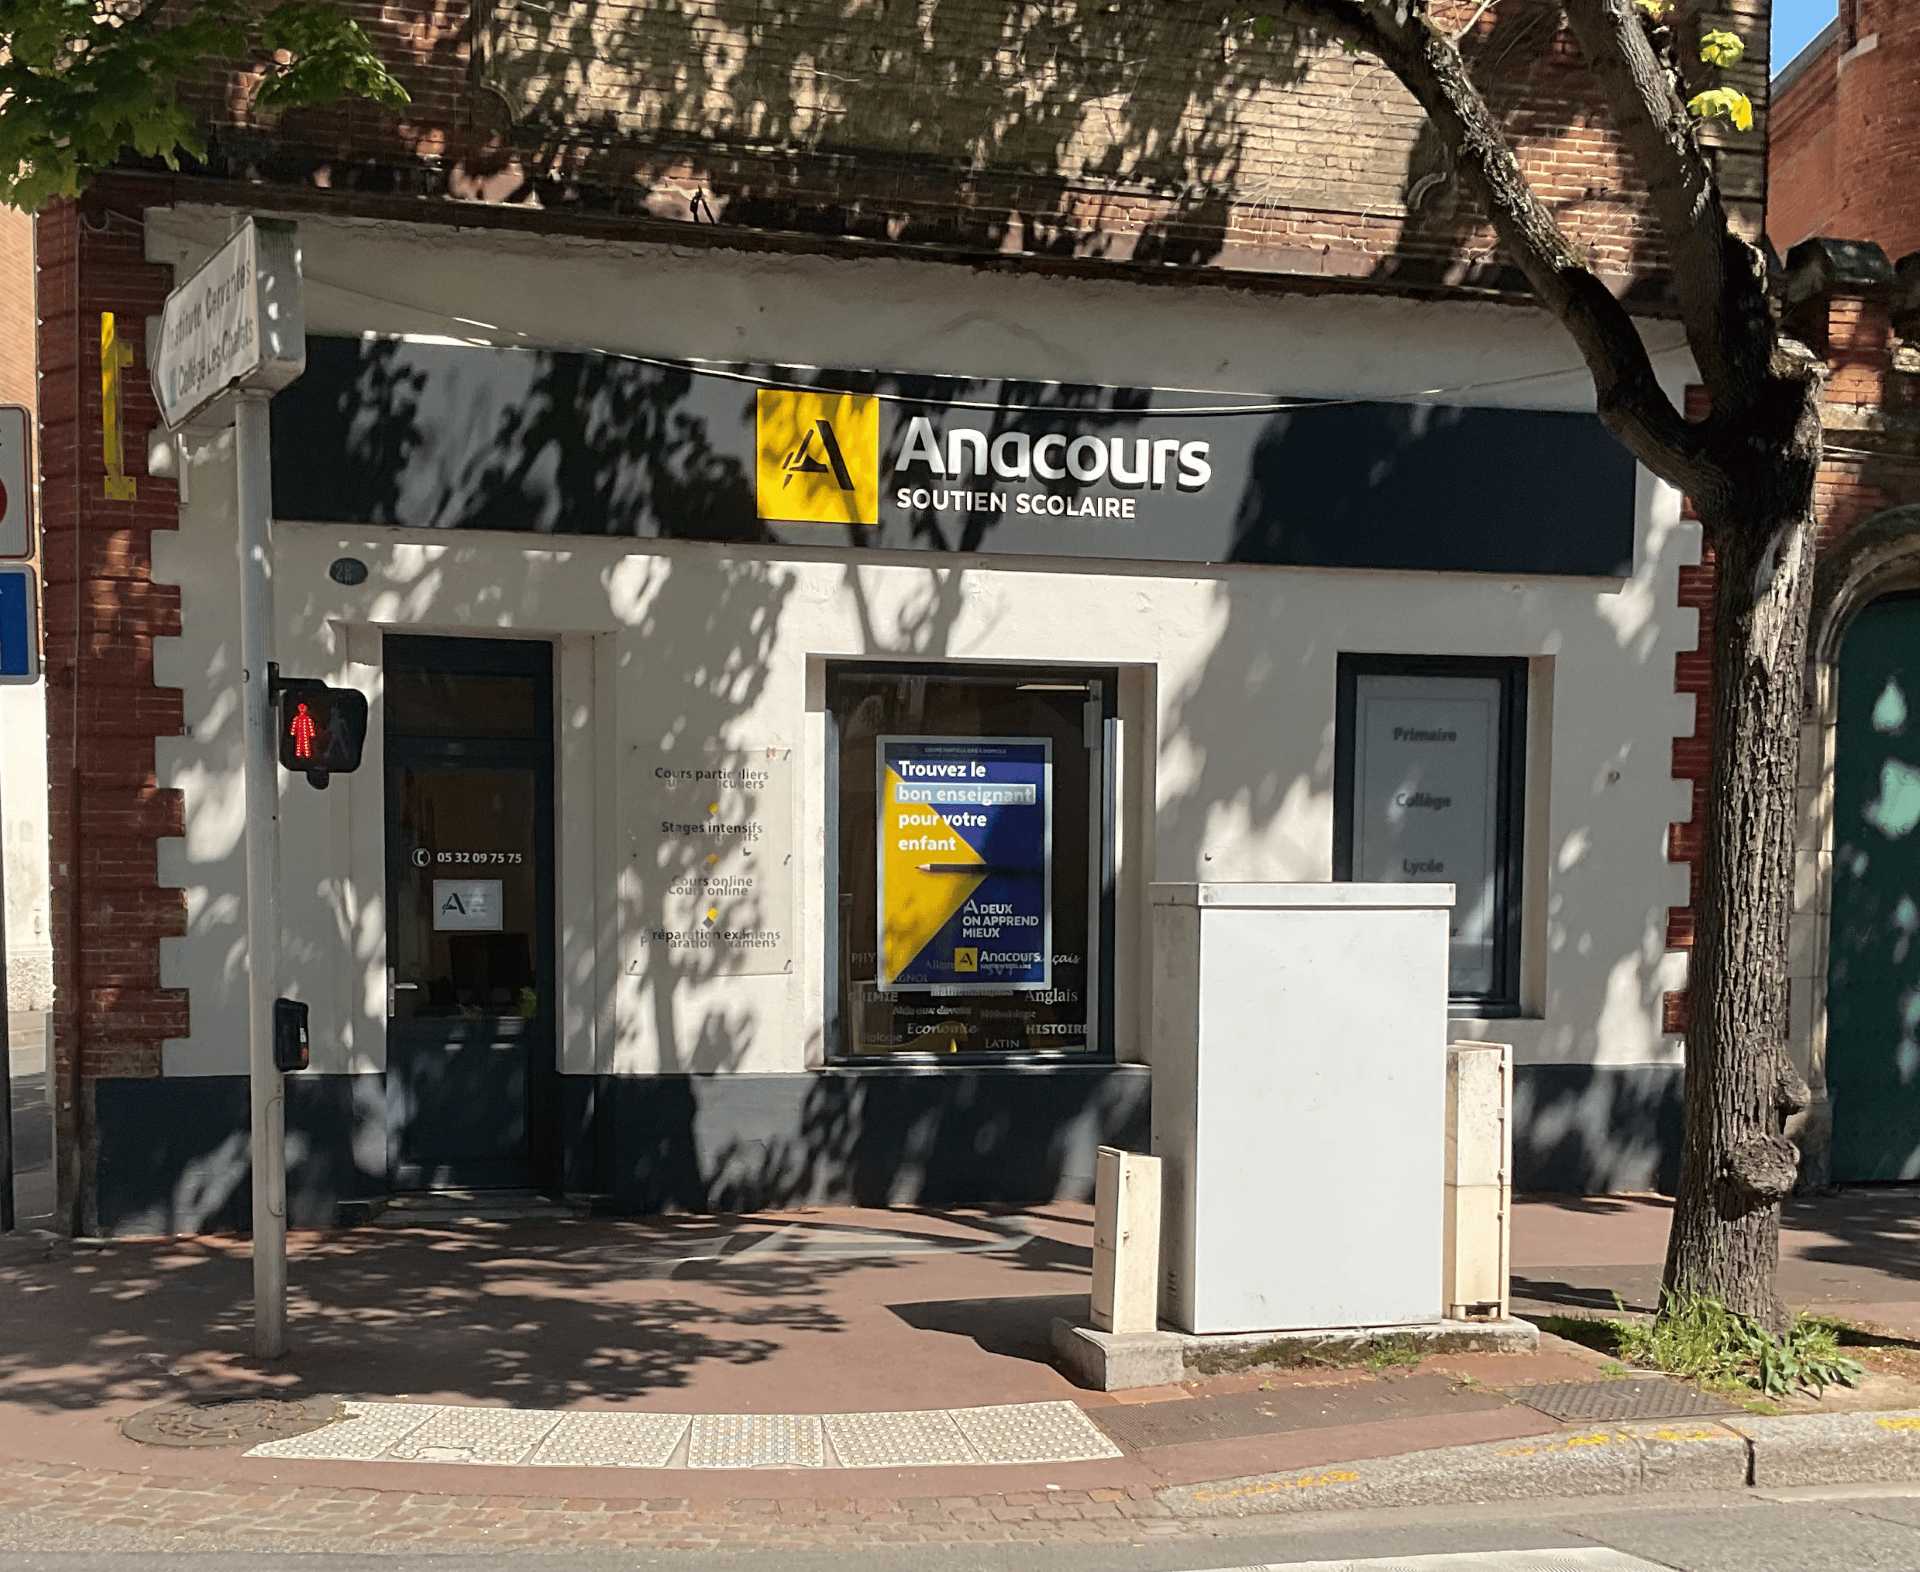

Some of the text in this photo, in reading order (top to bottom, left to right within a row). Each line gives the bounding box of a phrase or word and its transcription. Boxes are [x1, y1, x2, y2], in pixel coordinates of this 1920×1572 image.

[895, 416, 1212, 487] Anacours
[897, 488, 1136, 518] SOUTIEN SCOLAIRE
[695, 768, 769, 781] particliers
[898, 760, 986, 778] Trouvez le
[899, 786, 1032, 806] bon enseignant
[898, 812, 988, 829] pour votre
[661, 821, 763, 835] Stages intensifs
[898, 835, 956, 851] enfant
[437, 852, 522, 864] 05 32 09 75 75
[712, 875, 753, 887] online
[963, 899, 1013, 914] A DEUX
[962, 916, 1039, 926] ON APPREND
[962, 928, 1000, 938] MIEUX
[980, 951, 1041, 962] Anacours
[1024, 987, 1080, 1005] Anglais
[985, 1039, 1020, 1048] LATIN
